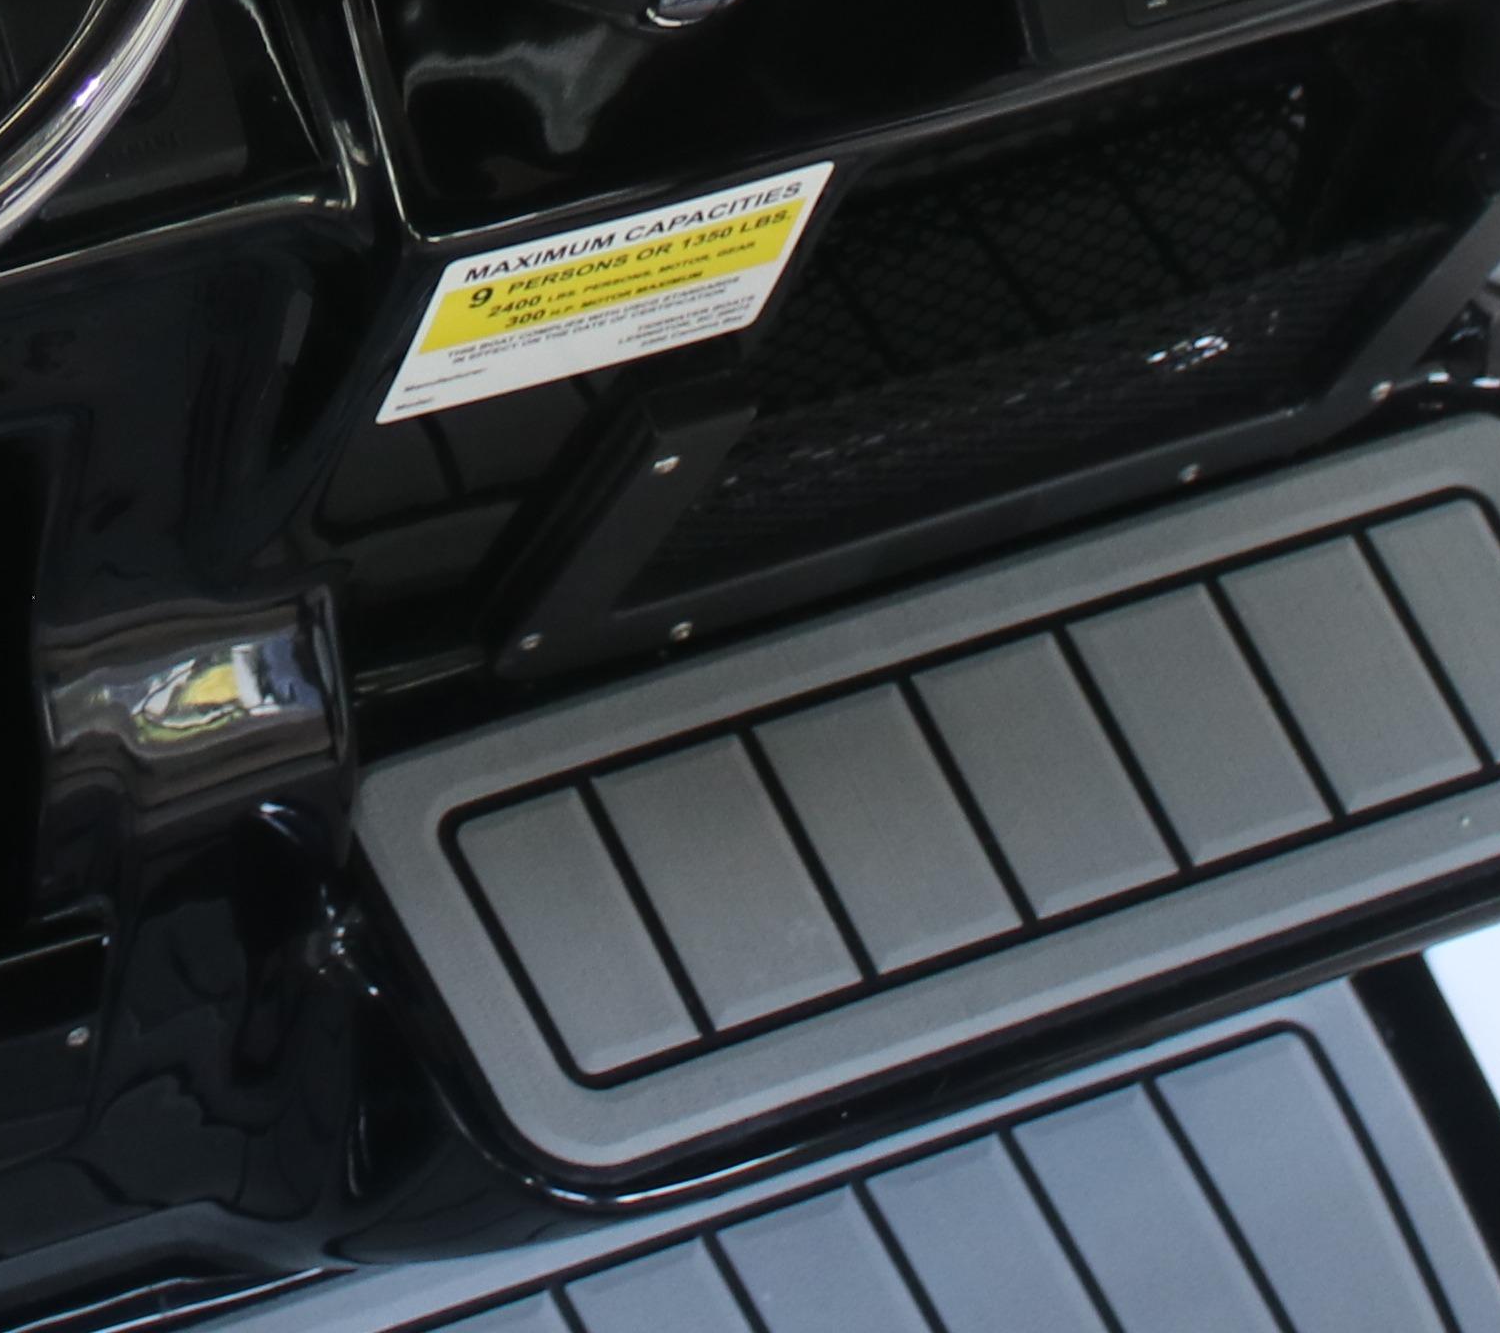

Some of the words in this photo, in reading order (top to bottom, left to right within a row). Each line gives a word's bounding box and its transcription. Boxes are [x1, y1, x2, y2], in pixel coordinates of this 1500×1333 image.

[464, 231, 617, 284] MAXIMUM
[624, 181, 803, 242] CAPACITIES
[468, 285, 496, 309] 9
[507, 252, 630, 296] PERSONS
[636, 240, 674, 261] OR
[682, 225, 734, 250] 1350
[487, 294, 542, 318] 2400
[505, 308, 546, 328] 300
